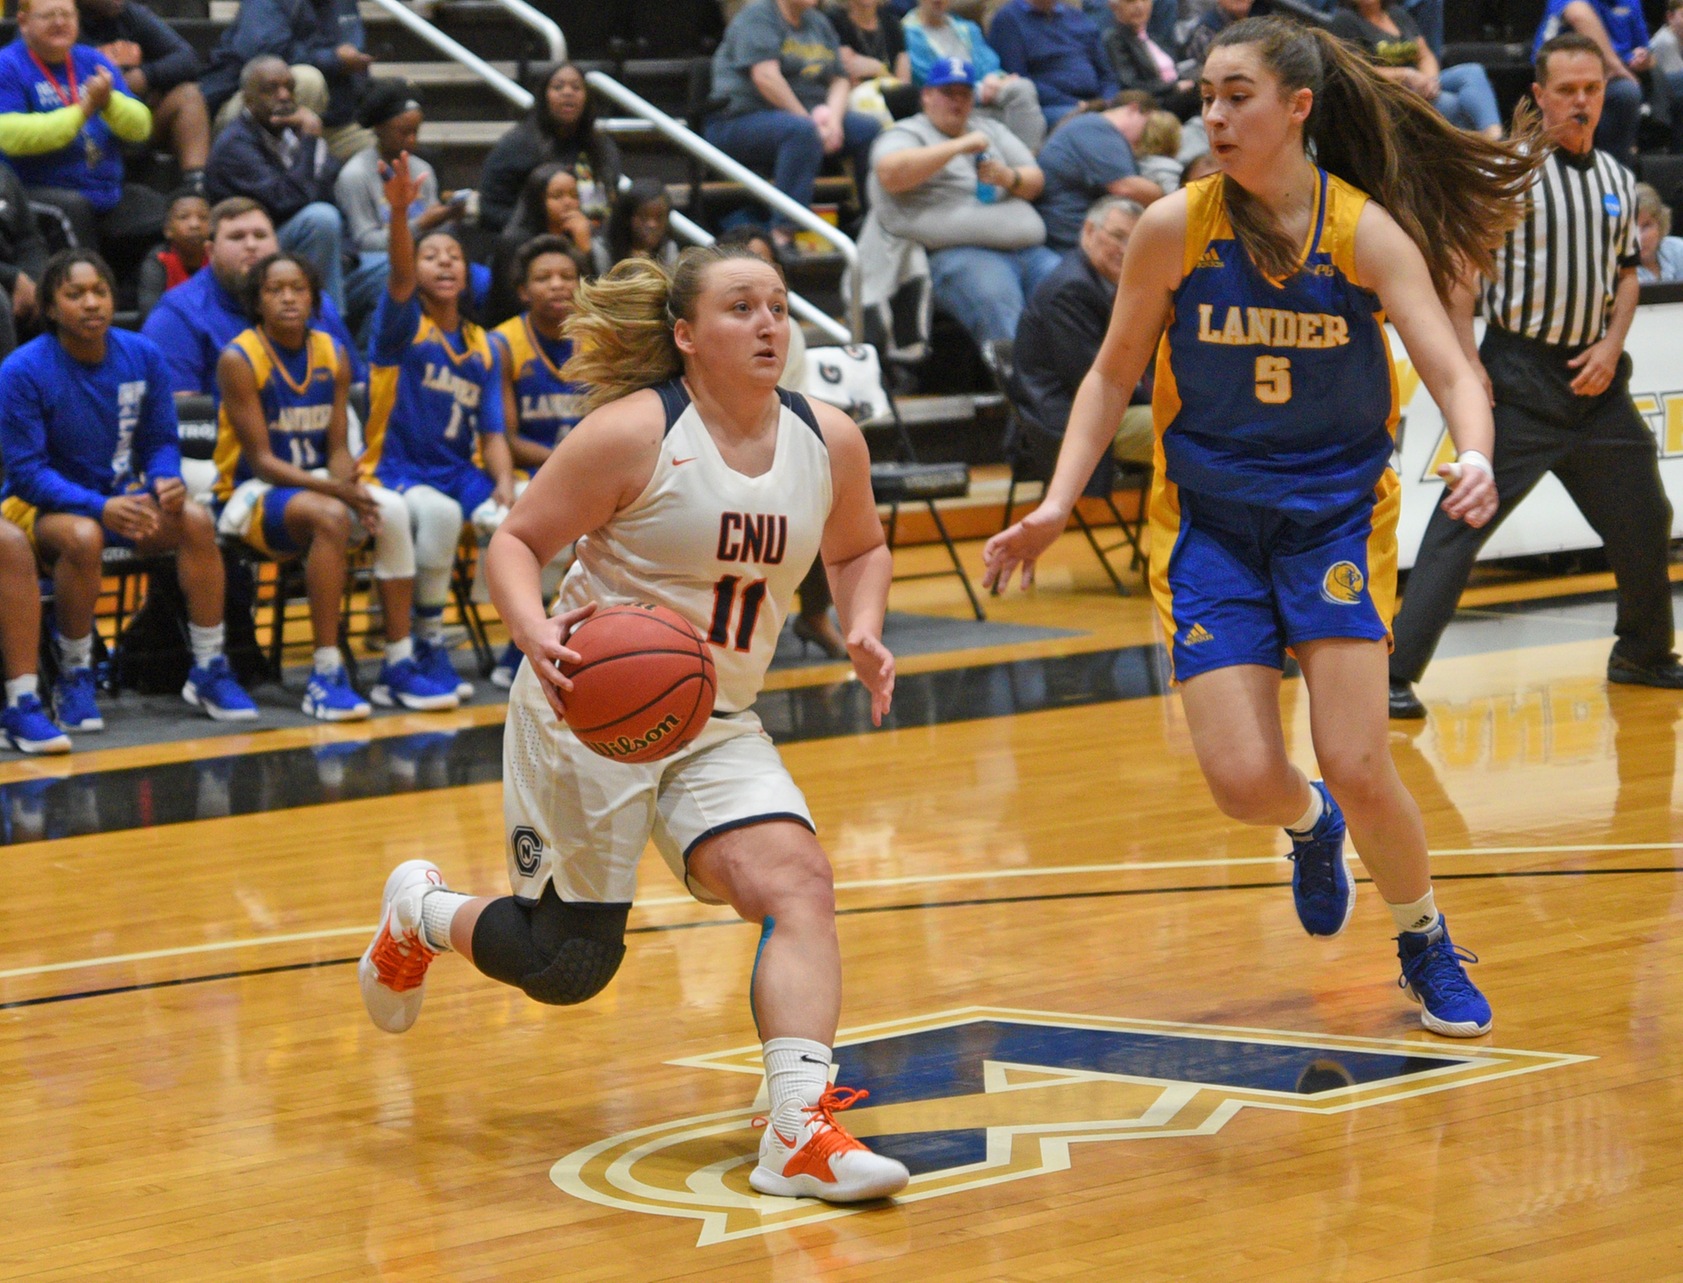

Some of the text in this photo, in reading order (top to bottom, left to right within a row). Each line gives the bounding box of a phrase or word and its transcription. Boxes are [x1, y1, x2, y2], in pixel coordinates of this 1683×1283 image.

[1198, 303, 1350, 348] LANDER
[1255, 354, 1293, 404] 5
[716, 511, 787, 565] CNU
[706, 574, 768, 653] 11
[585, 711, 681, 758] Wilson
